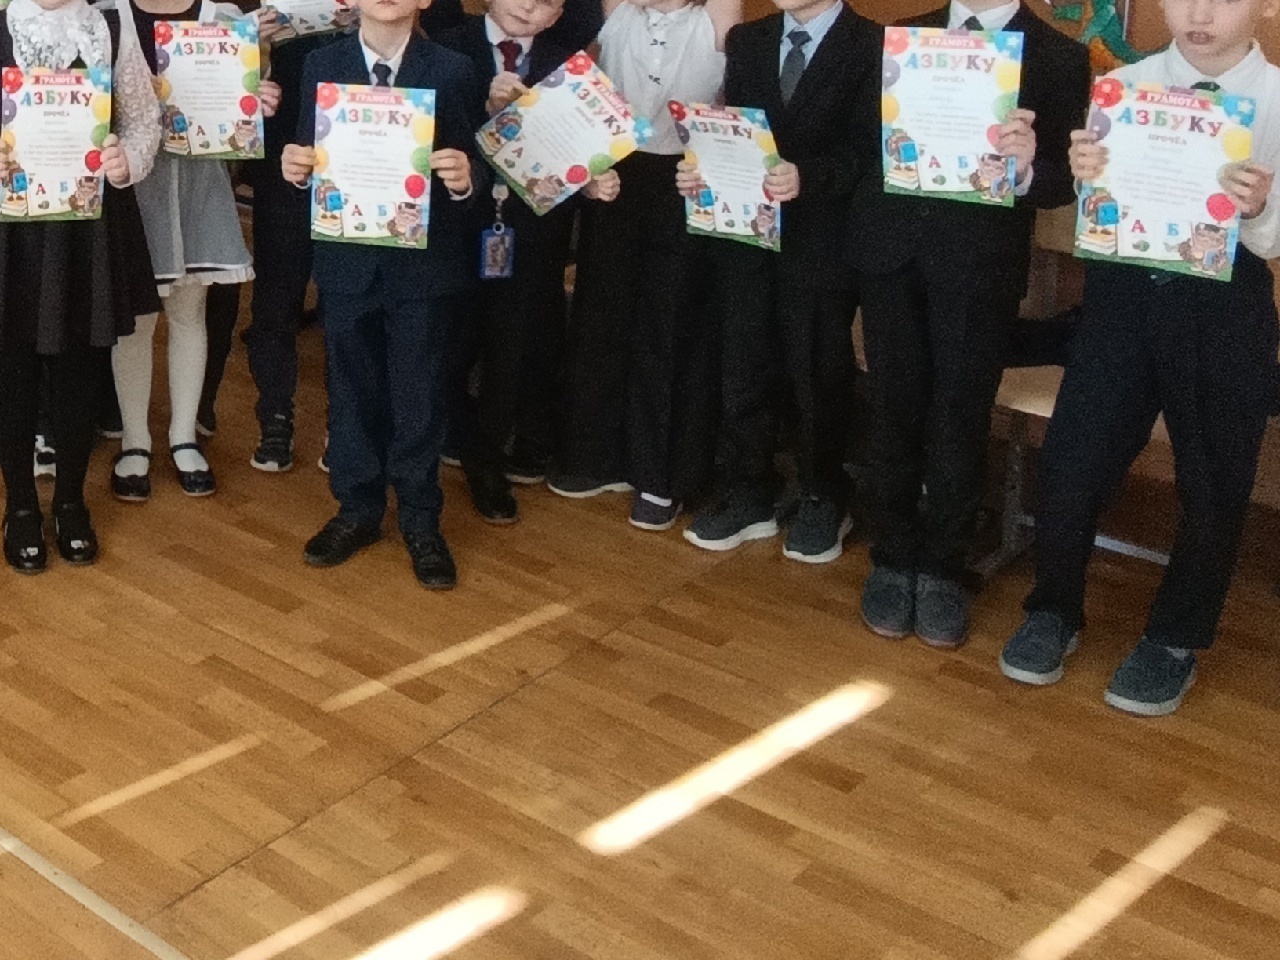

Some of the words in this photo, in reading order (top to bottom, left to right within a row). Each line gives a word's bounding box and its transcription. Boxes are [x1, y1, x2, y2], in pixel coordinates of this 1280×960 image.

[172, 42, 240, 56] АЗБУКУ
[904, 53, 996, 73] АЗБУКУ
[20, 90, 93, 107] АЗБУКУ
[1147, 92, 1202, 109] ГРАМОТА
[568, 81, 627, 136] АЗБУКУ
[336, 108, 414, 127] АЗБУКУ
[1117, 106, 1223, 138] АЗБУКУ
[196, 124, 206, 136] А
[690, 120, 752, 140] АЗБУКУ
[928, 156, 941, 168] А
[958, 156, 969, 168] Б
[36, 183, 46, 196] А
[351, 204, 363, 216] А
[377, 204, 388, 216] Б
[1131, 220, 1146, 234] А
[1166, 223, 1180, 236] Б
